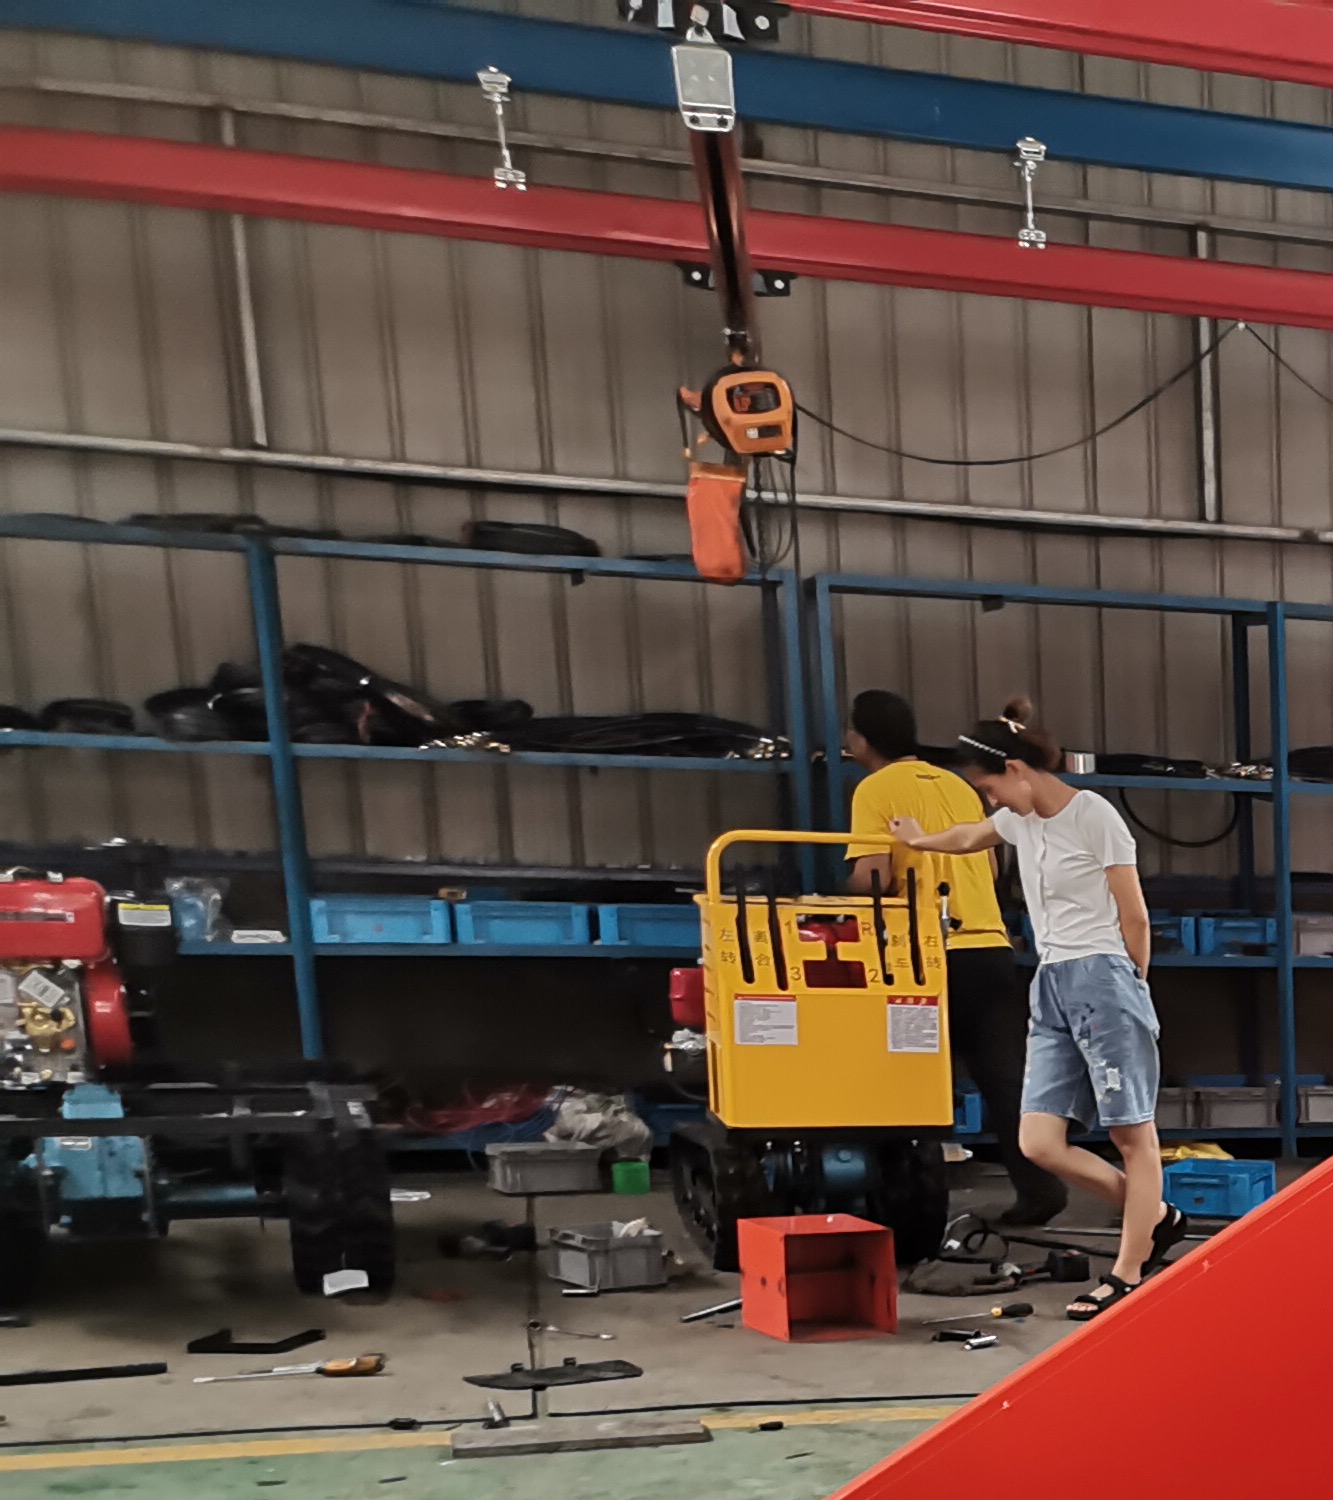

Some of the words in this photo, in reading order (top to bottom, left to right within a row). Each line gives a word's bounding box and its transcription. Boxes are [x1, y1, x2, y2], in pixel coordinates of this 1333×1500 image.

[861, 922, 873, 935] R
[790, 966, 802, 981] 3
[868, 968, 880, 983] 2
